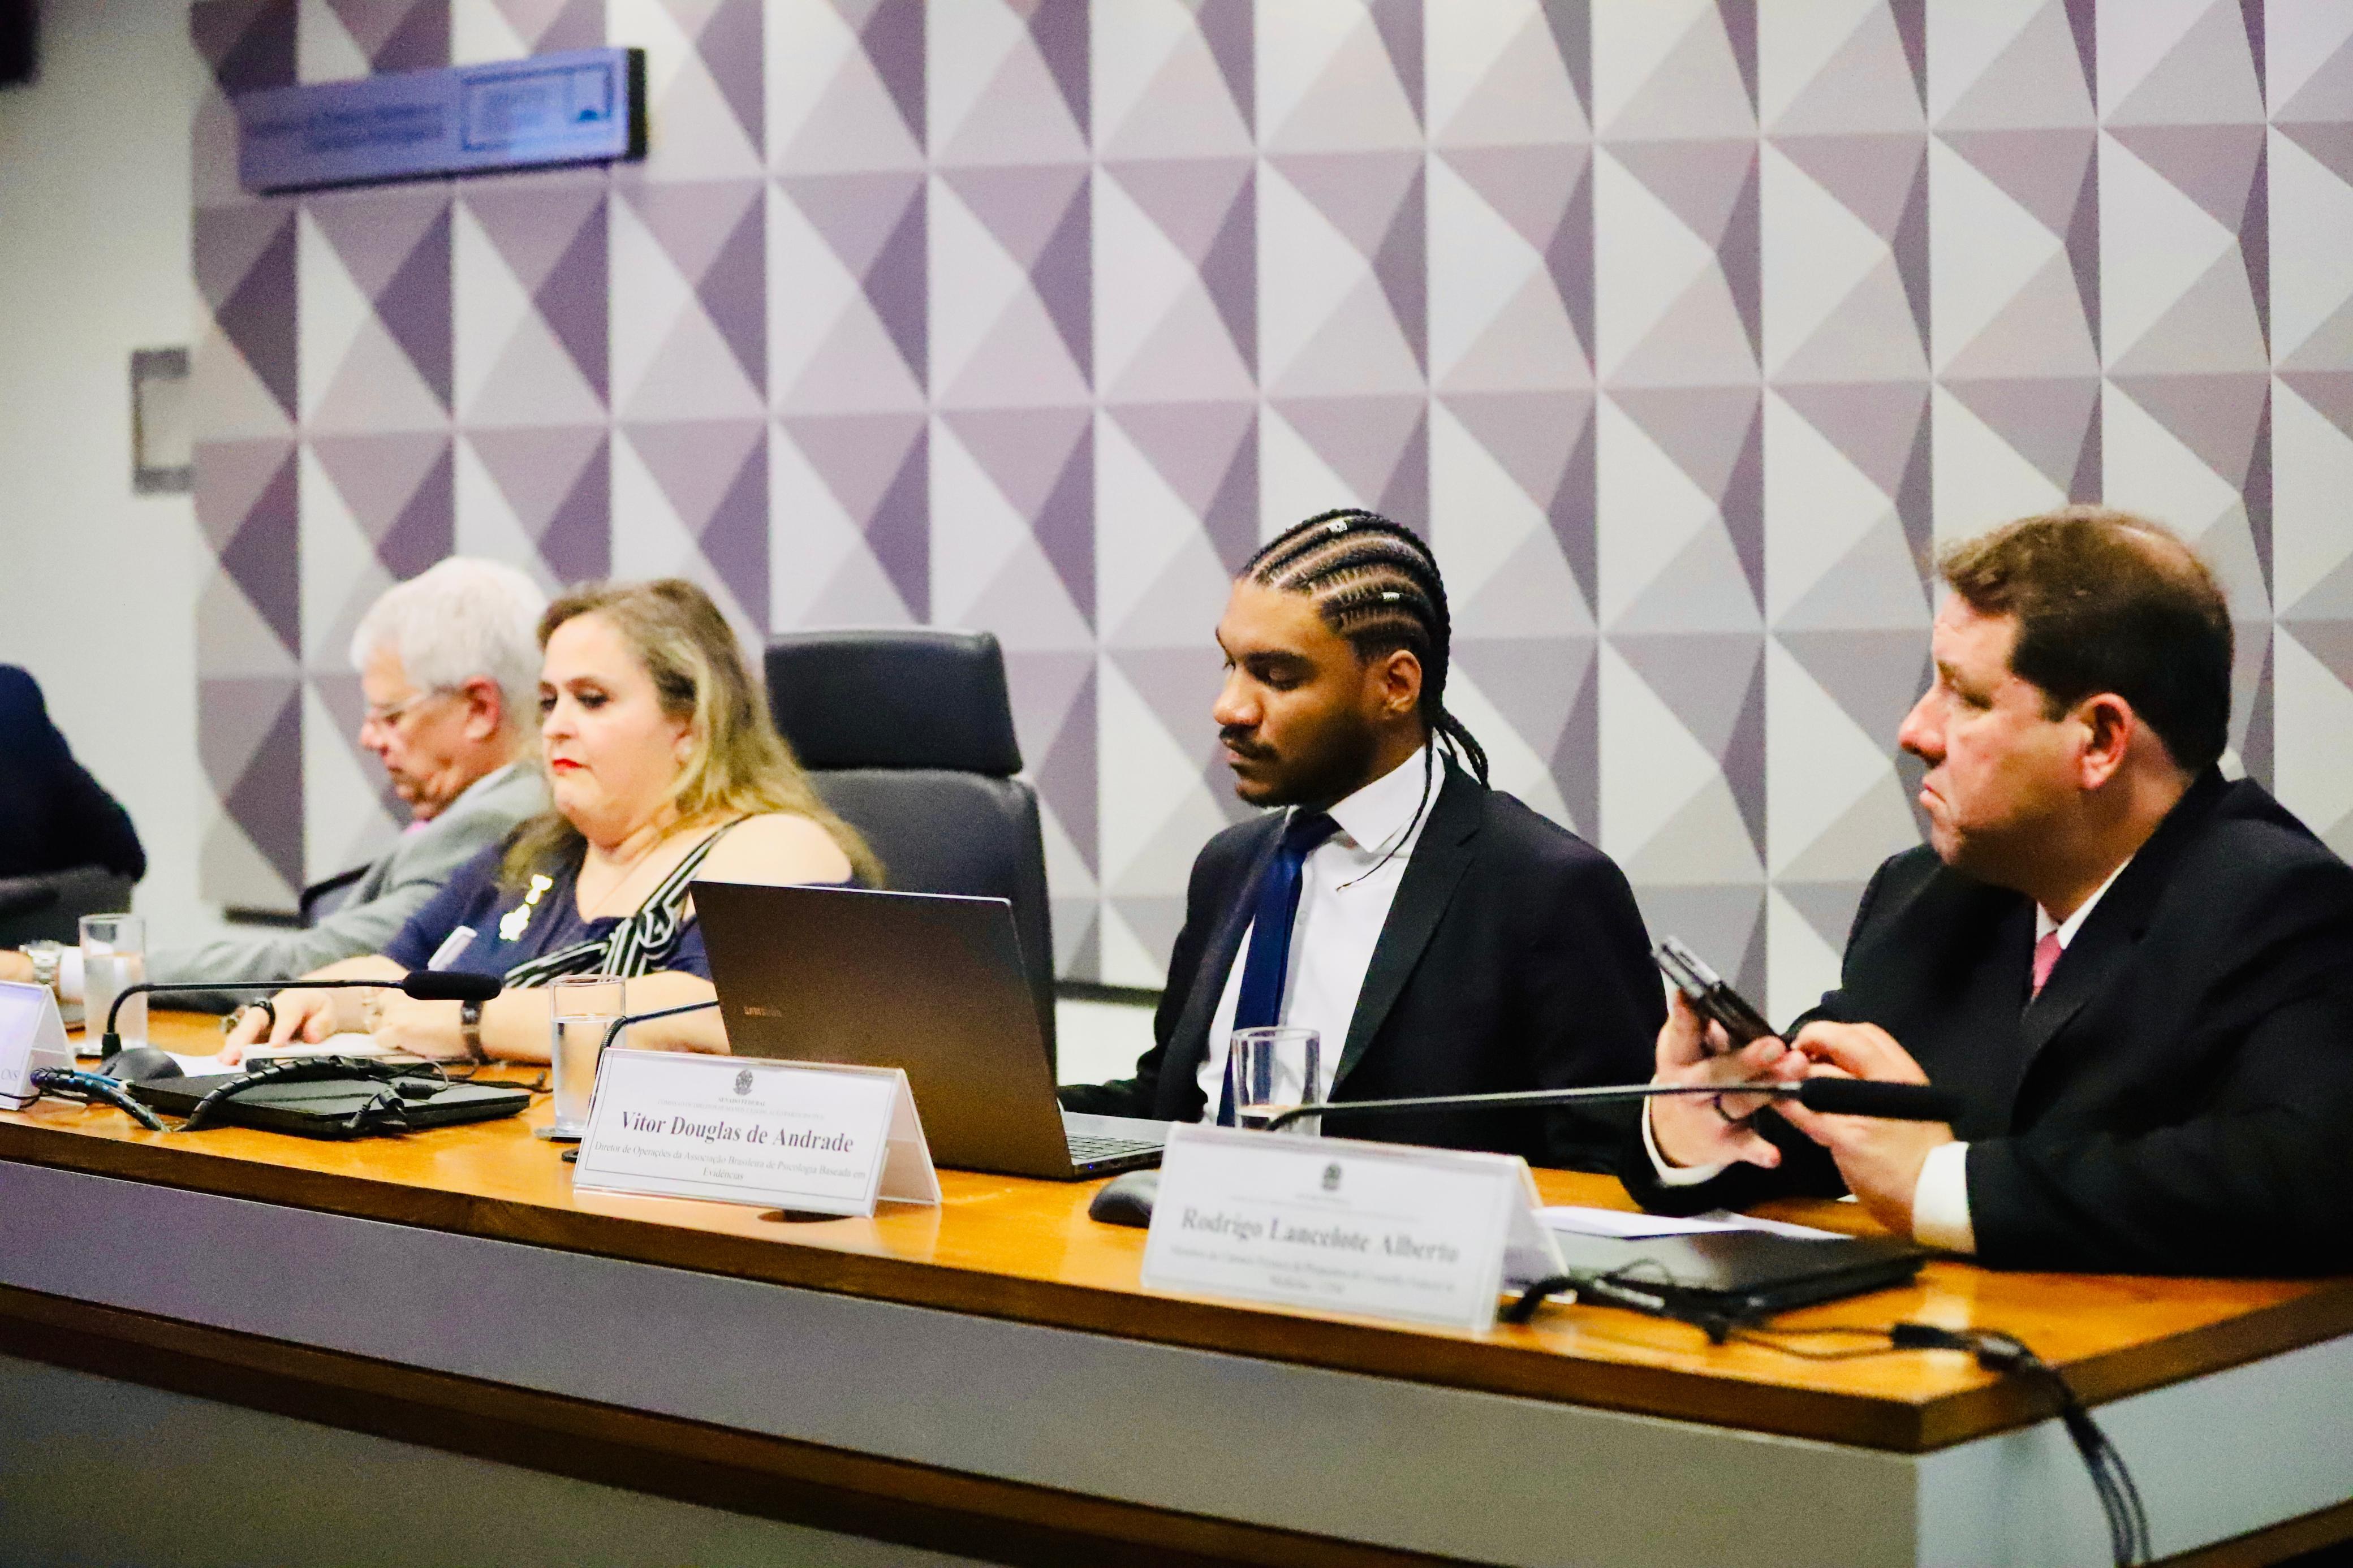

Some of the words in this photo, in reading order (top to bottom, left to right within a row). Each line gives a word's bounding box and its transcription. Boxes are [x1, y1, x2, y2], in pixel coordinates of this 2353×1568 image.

[622, 1111, 666, 1133] Vitor
[671, 1116, 742, 1144] Douglas
[746, 1124, 768, 1144] de
[772, 1127, 854, 1153] Andrade
[594, 1141, 620, 1153] Diretor
[622, 1143, 632, 1154] de
[632, 1145, 671, 1158] Operações
[673, 1148, 682, 1159] da
[683, 1151, 727, 1165] Associação
[728, 1155, 765, 1169] Brasileira
[766, 1160, 775, 1170] de
[777, 1160, 817, 1176] Psicologia
[819, 1165, 851, 1178] Baseada
[852, 1170, 866, 1180] em
[703, 1167, 744, 1181] Evidências
[1181, 1206, 1264, 1241] Rodrigo
[1269, 1217, 1370, 1253] Lancelote
[1379, 1234, 1460, 1264] Alberto
